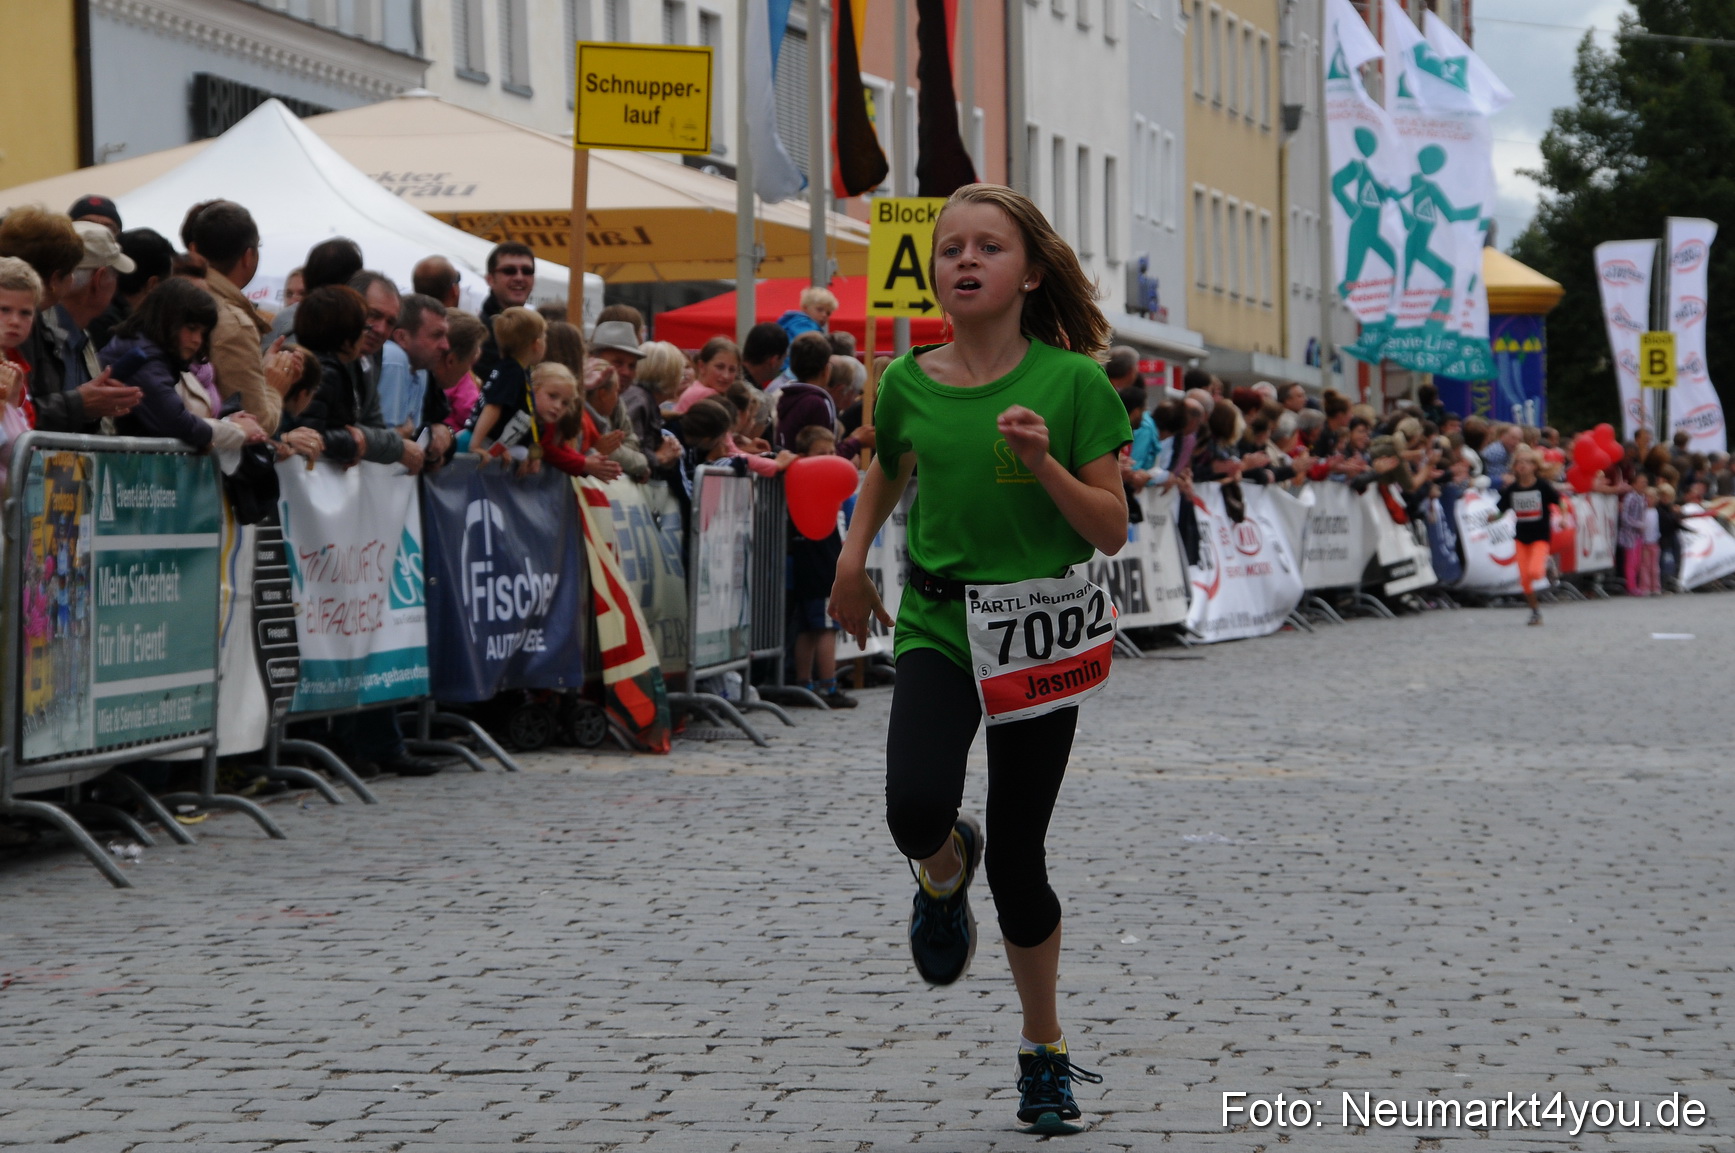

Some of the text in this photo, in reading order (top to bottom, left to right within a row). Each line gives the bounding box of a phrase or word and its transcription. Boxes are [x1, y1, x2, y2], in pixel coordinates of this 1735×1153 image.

[586, 73, 701, 100] Schnupper-
[623, 104, 661, 124] lauf
[879, 202, 937, 223] Block
[883, 233, 928, 290] A
[1649, 349, 1668, 376] B
[98, 561, 180, 606] Mehr Sicherheit
[470, 556, 560, 623] Fischer
[970, 597, 1027, 614] PARTL
[987, 589, 1113, 666] 7002
[98, 620, 168, 666] für Ihr Event!
[981, 666, 988, 676] 5
[1025, 659, 1103, 700] Jasmin
[97, 708, 113, 735] Miet
